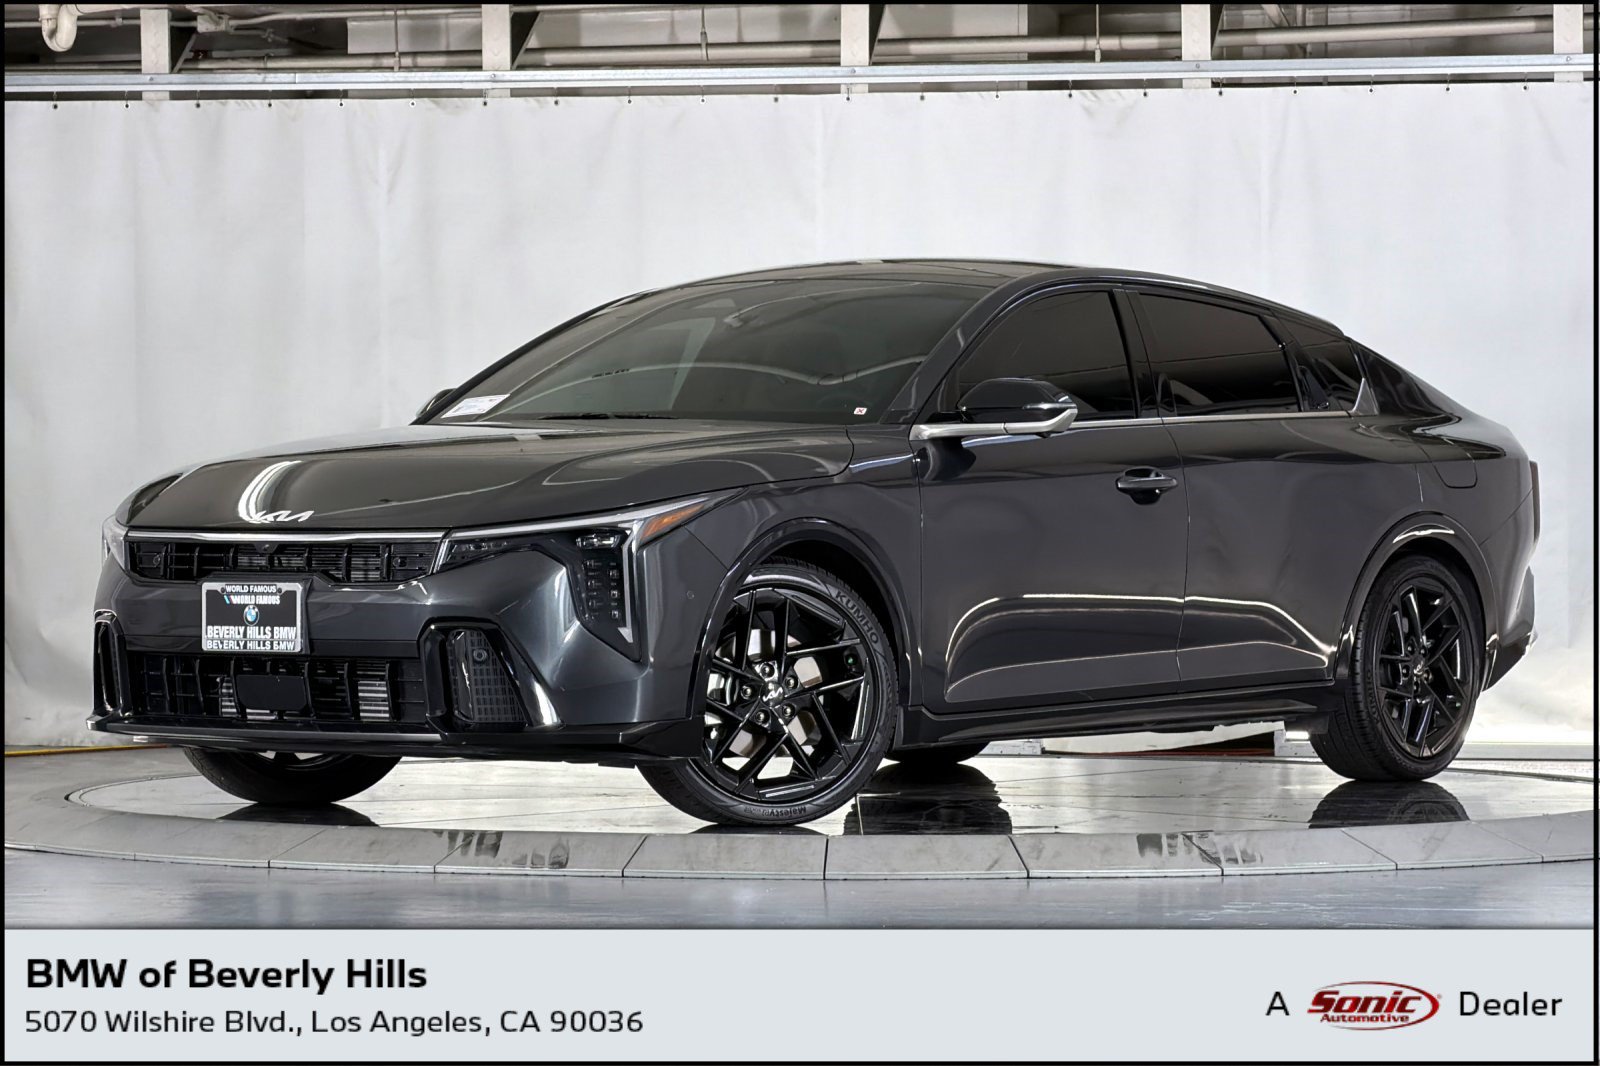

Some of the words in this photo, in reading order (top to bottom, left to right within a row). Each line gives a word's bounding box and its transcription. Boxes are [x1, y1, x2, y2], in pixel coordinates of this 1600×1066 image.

[226, 585, 249, 593] WORLD
[249, 585, 277, 593] FAMOUS
[230, 594, 255, 605] WORLD
[256, 594, 281, 605] FAMOUS
[835, 591, 879, 644] KUMHO
[207, 625, 245, 639] BEVERLY
[246, 626, 272, 639] HILLS
[273, 626, 297, 640] BMW
[206, 640, 245, 650] BEVERLY
[246, 640, 271, 650] HILLS
